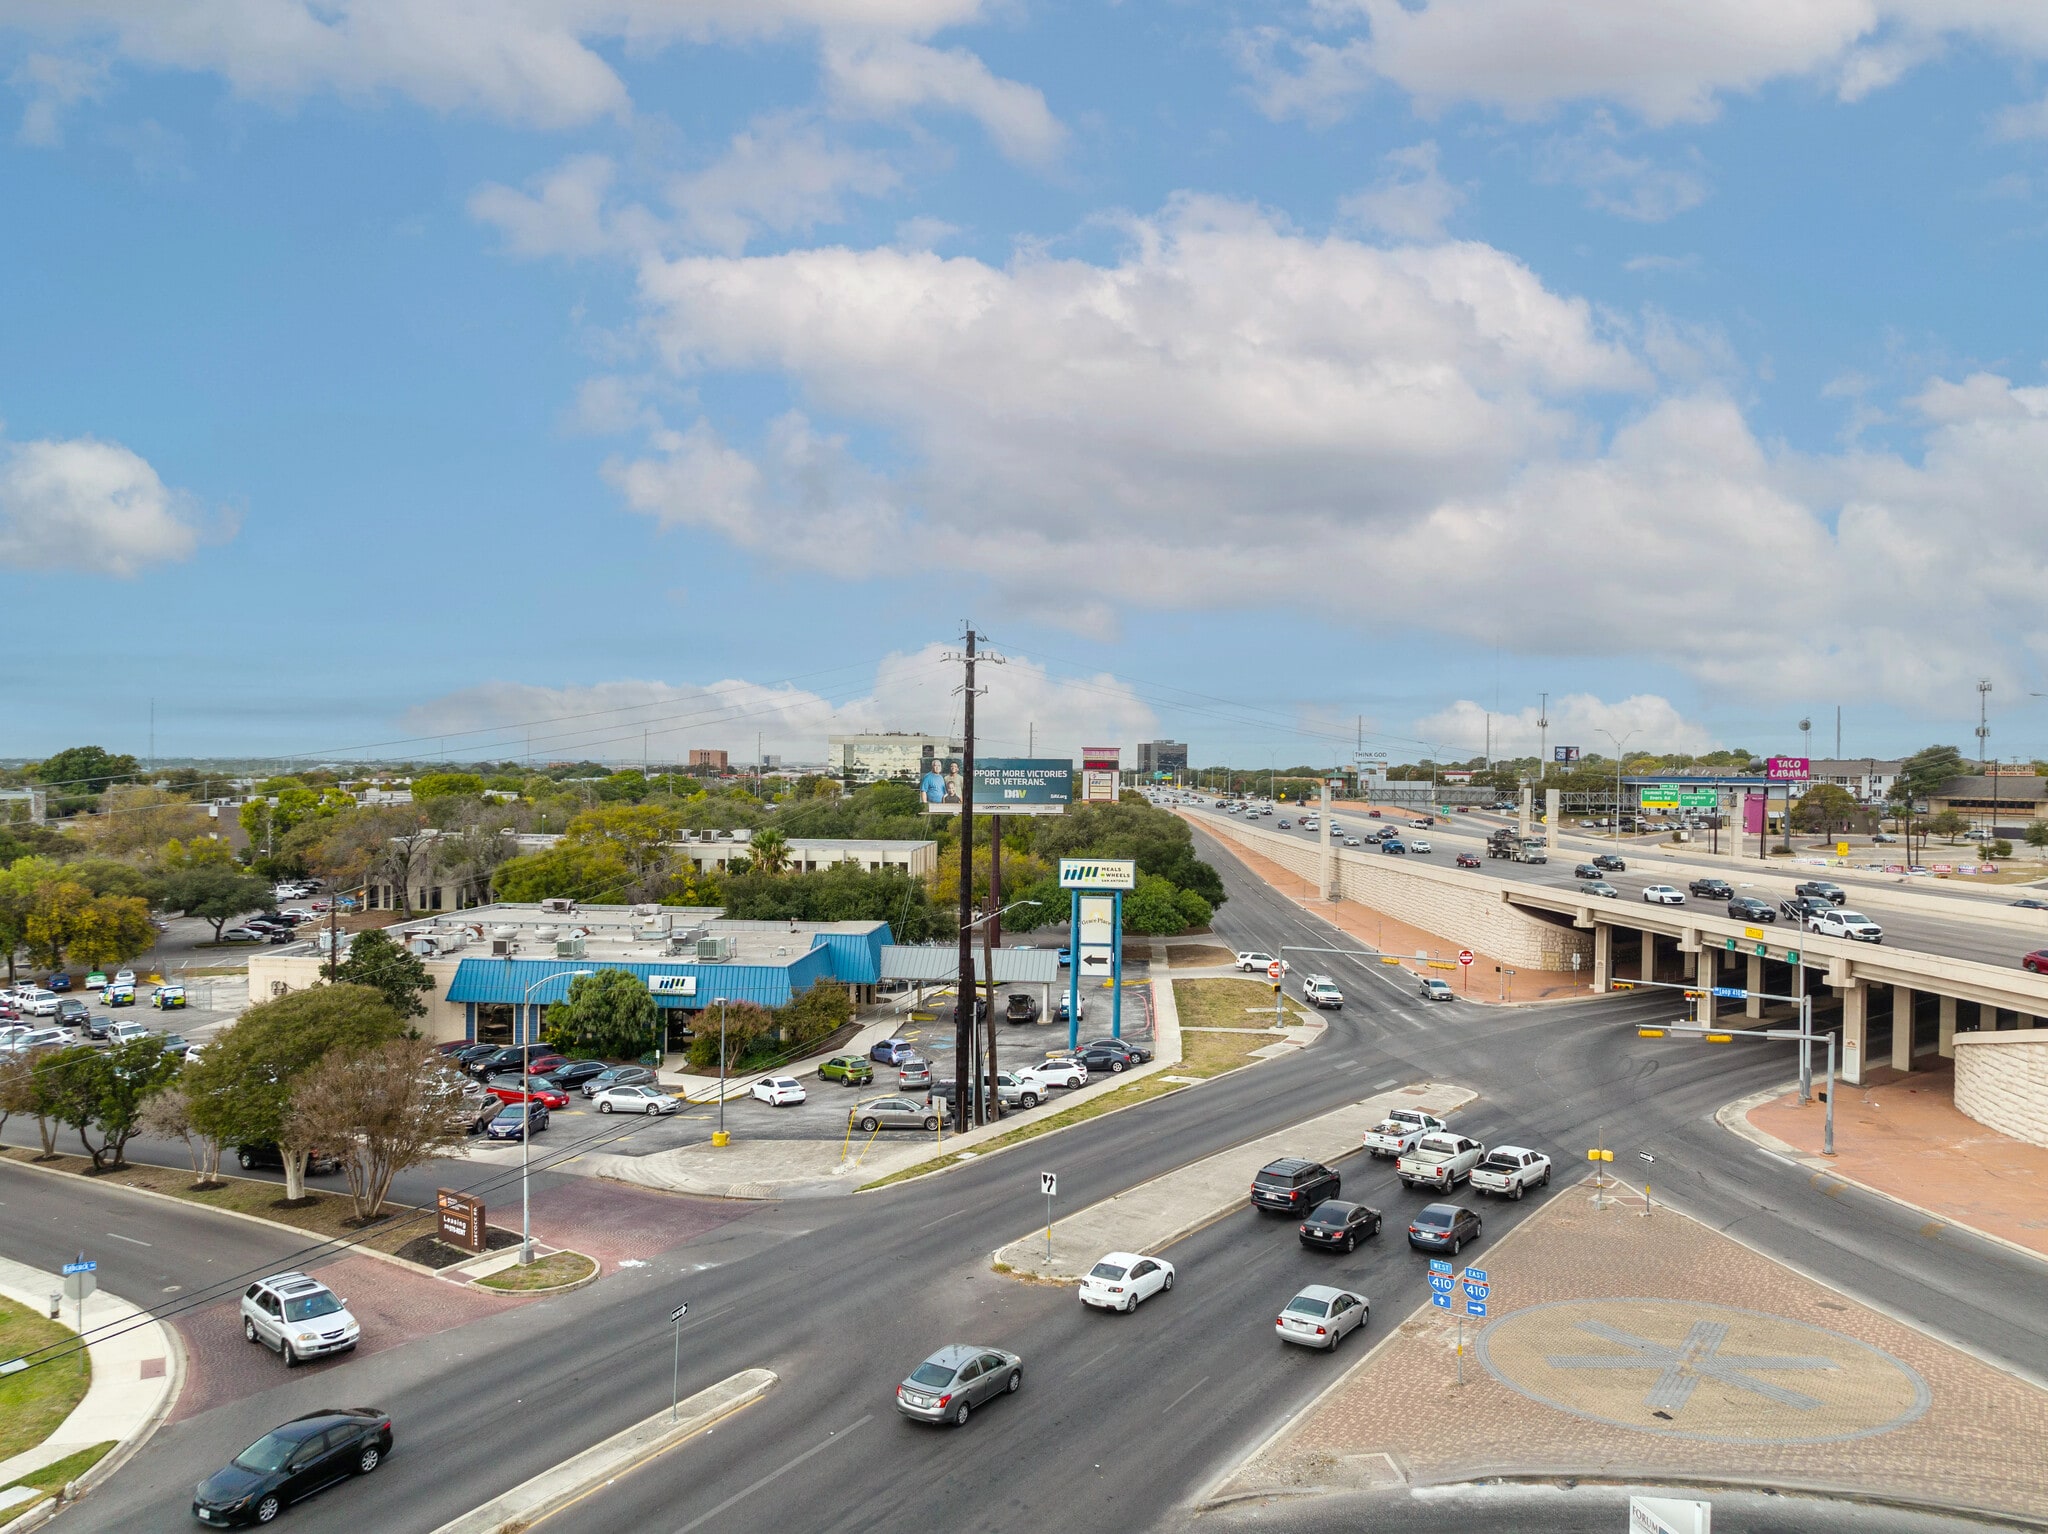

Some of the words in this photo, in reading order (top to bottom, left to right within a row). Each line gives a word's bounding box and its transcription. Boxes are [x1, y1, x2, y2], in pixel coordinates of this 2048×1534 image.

[1776, 760, 1801, 768] TACO
[973, 769, 1000, 777] PPORT
[1002, 769, 1026, 777] MORE
[1026, 769, 1068, 778] VICTORIES
[1770, 769, 1808, 778] CABANA
[1002, 778, 1046, 786] VETERANS.
[1004, 789, 1027, 798] DAV
[1720, 989, 1731, 997] Loop
[443, 1215, 466, 1229] Leasing
[1433, 1263, 1450, 1271] WEST
[1468, 1271, 1484, 1279] EAST
[1432, 1278, 1452, 1289] 410
[1466, 1285, 1486, 1297] 410
[1632, 1505, 1658, 1532] FORUM
